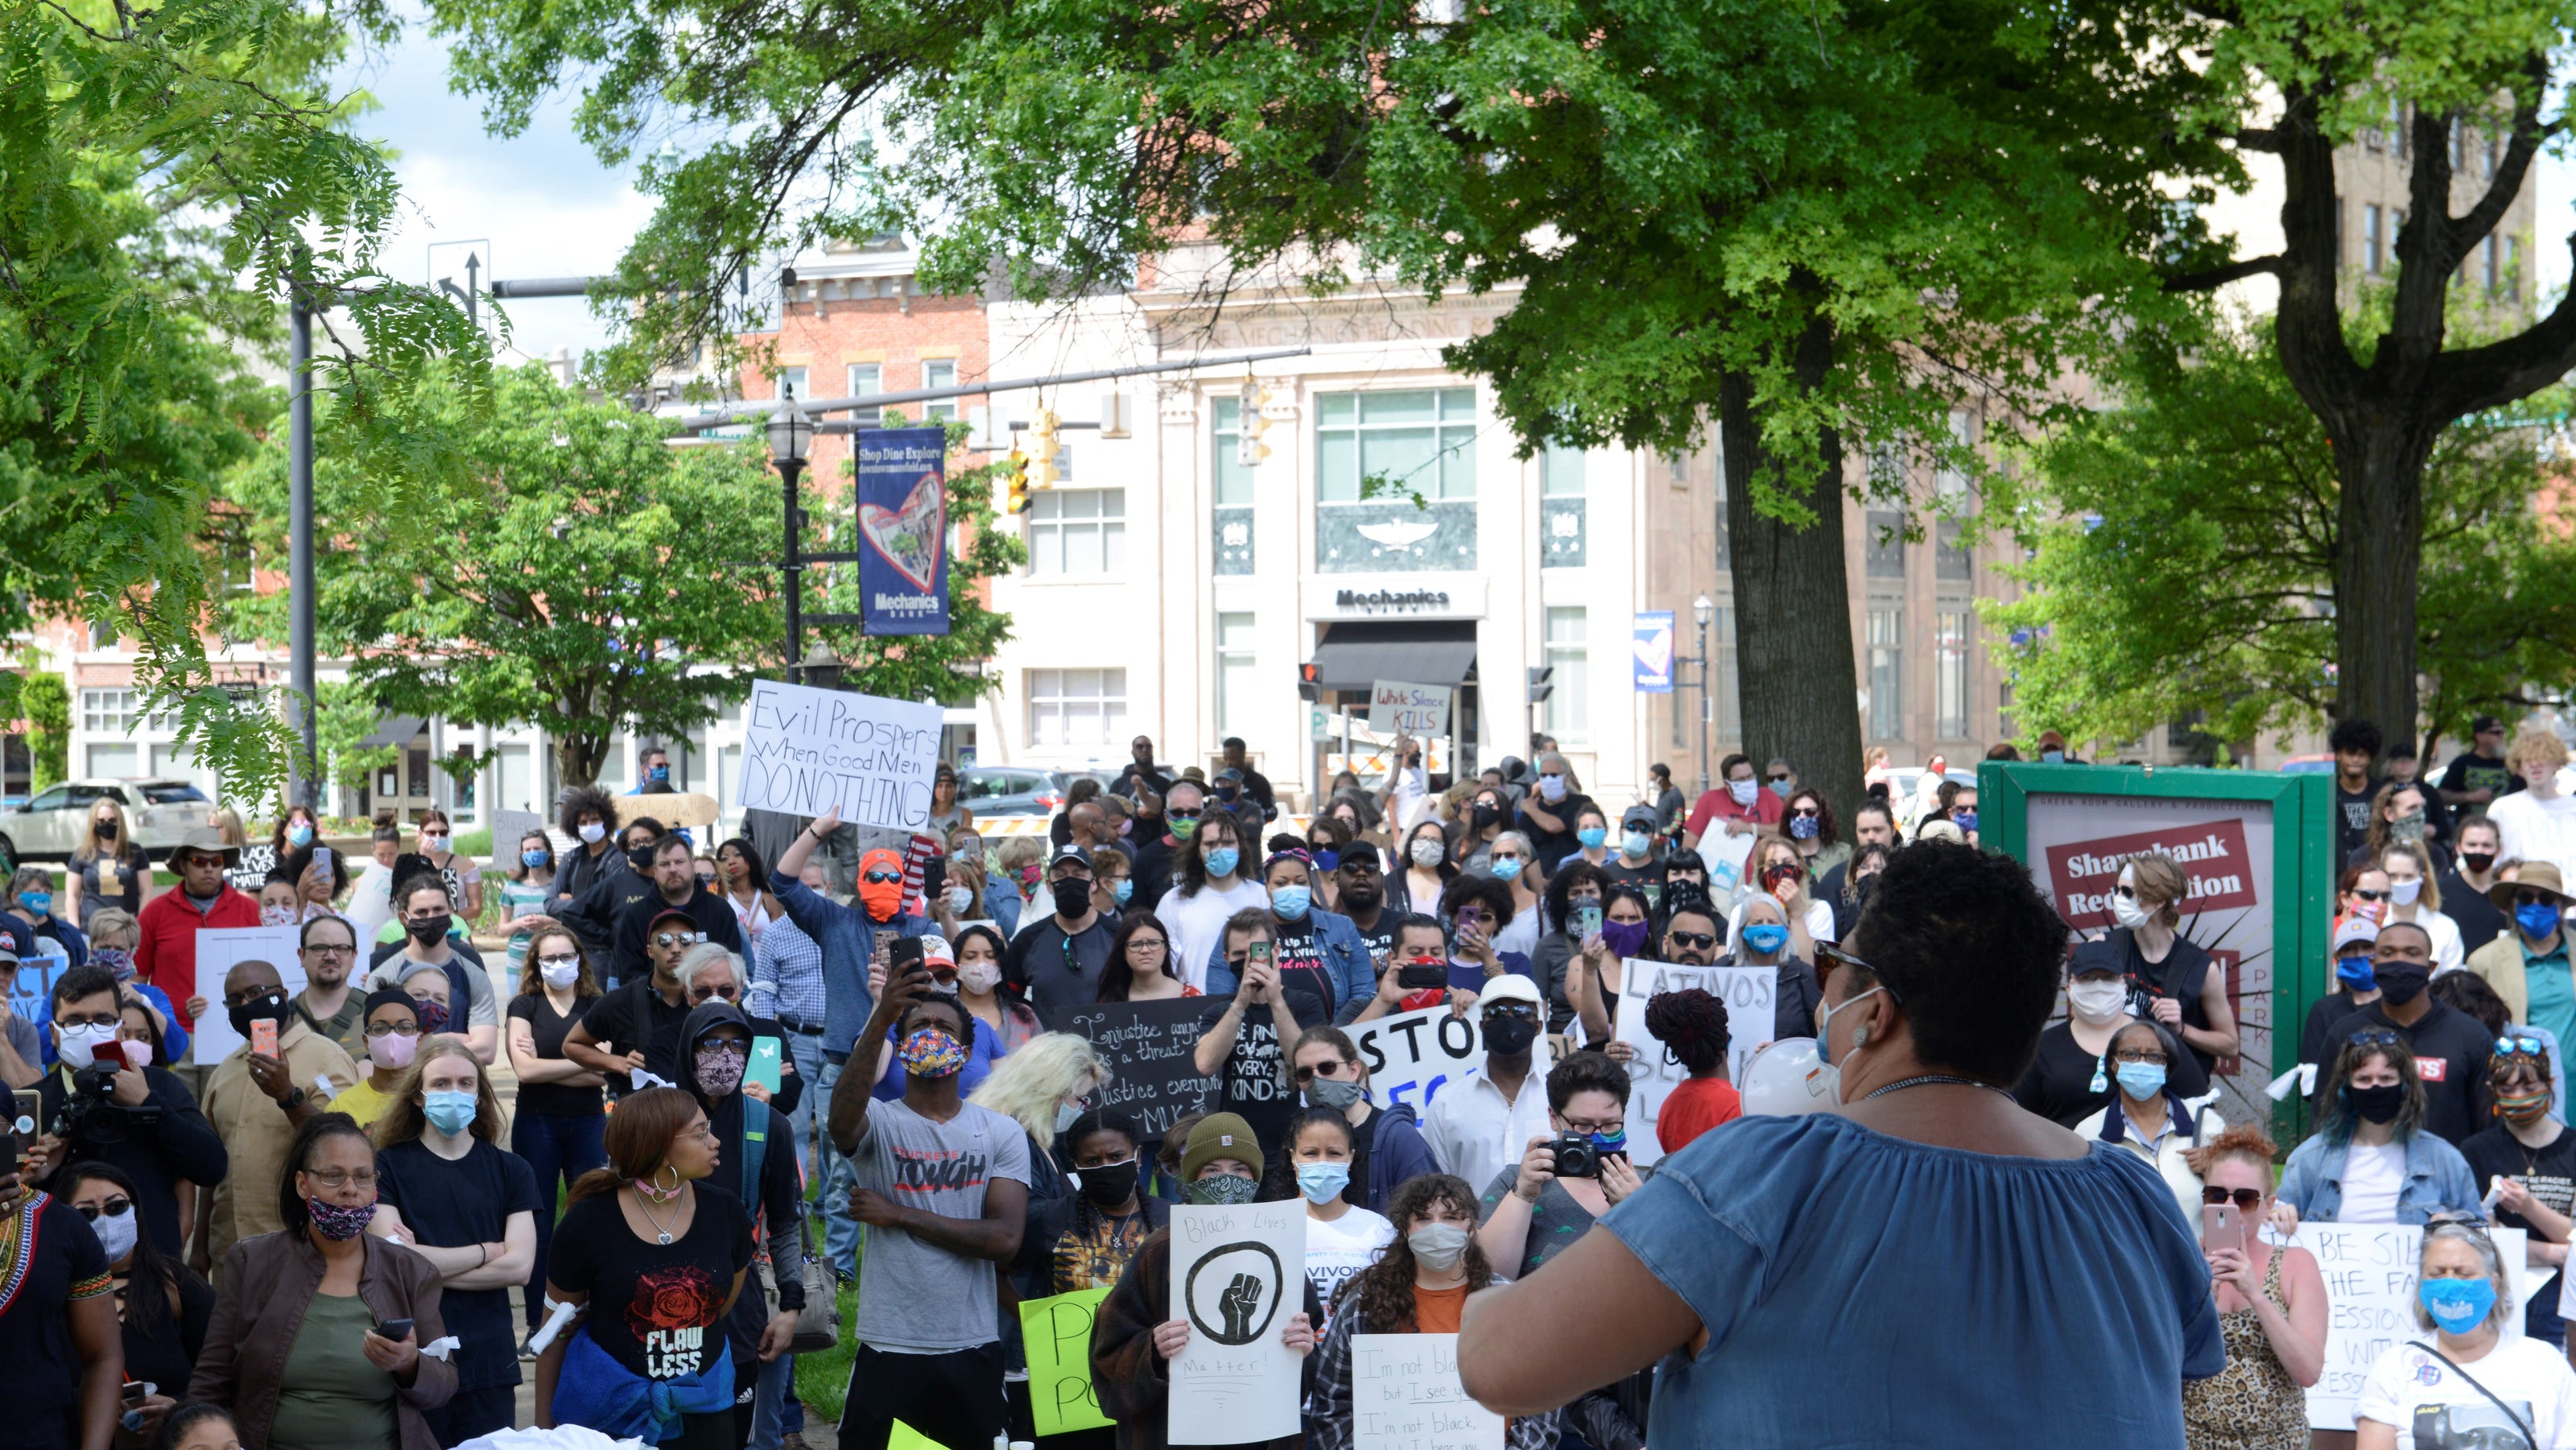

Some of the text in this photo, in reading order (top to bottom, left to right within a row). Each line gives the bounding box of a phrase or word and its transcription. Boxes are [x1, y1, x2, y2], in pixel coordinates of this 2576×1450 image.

[1370, 316, 1466, 343] BUDING
[859, 446, 941, 463] Shop Dine Explore
[875, 593, 939, 610] Mechanics
[1336, 589, 1449, 605] Mechanics
[1377, 688, 1408, 705] White
[753, 689, 940, 756] Evil Prospers
[1393, 710, 1435, 729] KILLS
[747, 731, 921, 775] When Good Men
[2041, 798, 2074, 806] GREEN
[2082, 799, 2107, 807] ROOM
[2116, 799, 2169, 809] GALLERY
[2185, 802, 2262, 812] PRODUCTIONS
[2067, 874, 2243, 915] Redtion
[1285, 938, 1301, 947] Up
[1626, 960, 1773, 1009] LATINOS
[2254, 969, 2268, 1044] PARK
[1073, 1013, 1162, 1050] Injustice
[1360, 1012, 1488, 1075] STO
[1122, 1054, 1132, 1064] a
[1137, 1038, 1185, 1060] threat
[1232, 1060, 1269, 1076] EVERY
[1084, 1077, 1157, 1109] Justice
[1232, 1078, 1274, 1101] KIND
[894, 1146, 958, 1160] BUCKEYE
[1184, 1211, 1286, 1243] Black Lives
[2318, 1231, 2361, 1262] BE
[646, 1327, 703, 1353] FLAW
[2344, 1339, 2402, 1365] WIT
[648, 1351, 702, 1378] LESS
[1359, 1349, 1393, 1378] I'm
[1402, 1353, 1423, 1374] not
[1384, 1384, 1402, 1401] but
[1408, 1382, 1422, 1400] I
[1426, 1386, 1447, 1399] see
[1362, 1411, 1395, 1435] I'm
[1404, 1417, 1424, 1434] not
